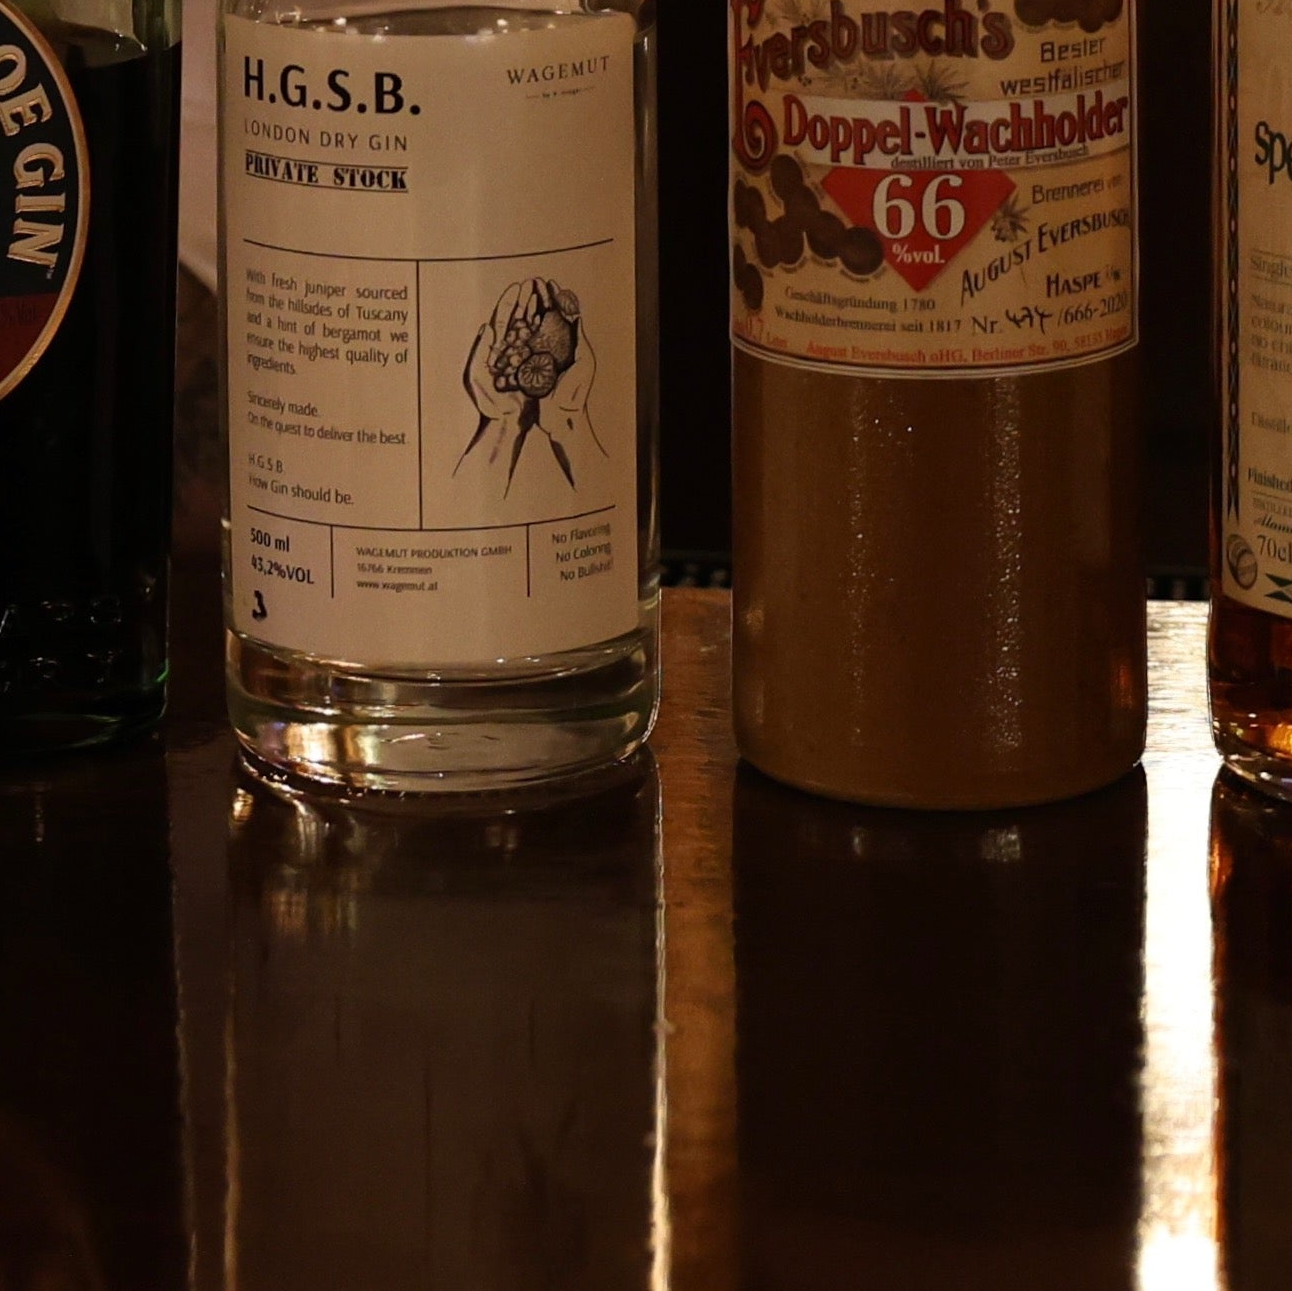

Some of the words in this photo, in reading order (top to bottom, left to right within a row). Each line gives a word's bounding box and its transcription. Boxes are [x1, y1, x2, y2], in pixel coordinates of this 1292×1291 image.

[1040, 37, 1107, 63] Bester
[506, 55, 611, 86] WAGEMUT
[244, 55, 421, 116] H.G.S.B.
[244, 118, 310, 145] LONDON
[319, 130, 359, 150] DRY
[368, 133, 408, 152] GIN
[782, 88, 1130, 166] Doppel-Wachholder
[245, 151, 319, 185] PRIVATE
[332, 166, 407, 190] STOCK
[959, 158, 984, 169] von
[988, 154, 1021, 168] Peter
[7, 141, 66, 267] GIN
[1031, 178, 1105, 205] Brennerei
[872, 173, 966, 240] 66
[271, 272, 297, 291] fresh
[304, 279, 347, 299] juniper
[355, 285, 409, 301] sourced
[960, 240, 1032, 309] AUGUST
[1045, 270, 1102, 299] HASPE
[268, 293, 285, 311] the
[287, 297, 333, 317] hillsides
[337, 302, 351, 319] of
[355, 305, 409, 326] Tuscany
[266, 318, 272, 329] a
[277, 315, 297, 333] hint
[303, 321, 316, 336] of
[322, 322, 382, 344] bergamot
[390, 330, 409, 343] we
[899, 318, 924, 333] seit
[929, 317, 962, 334] 1817
[278, 338, 295, 354] the
[298, 340, 340, 362] highest
[345, 347, 390, 367] quality
[394, 348, 409, 364] of
[275, 421, 301, 437] quest
[303, 423, 315, 438] to
[316, 425, 355, 443] deliver
[357, 429, 377, 443] the
[270, 479, 289, 495] Gin
[291, 483, 332, 503] should
[250, 526, 271, 548] 500
[274, 535, 290, 553] ml
[411, 546, 479, 559] PRODUKTION
[552, 532, 567, 544] No
[556, 551, 571, 563] No
[560, 569, 576, 581] No
